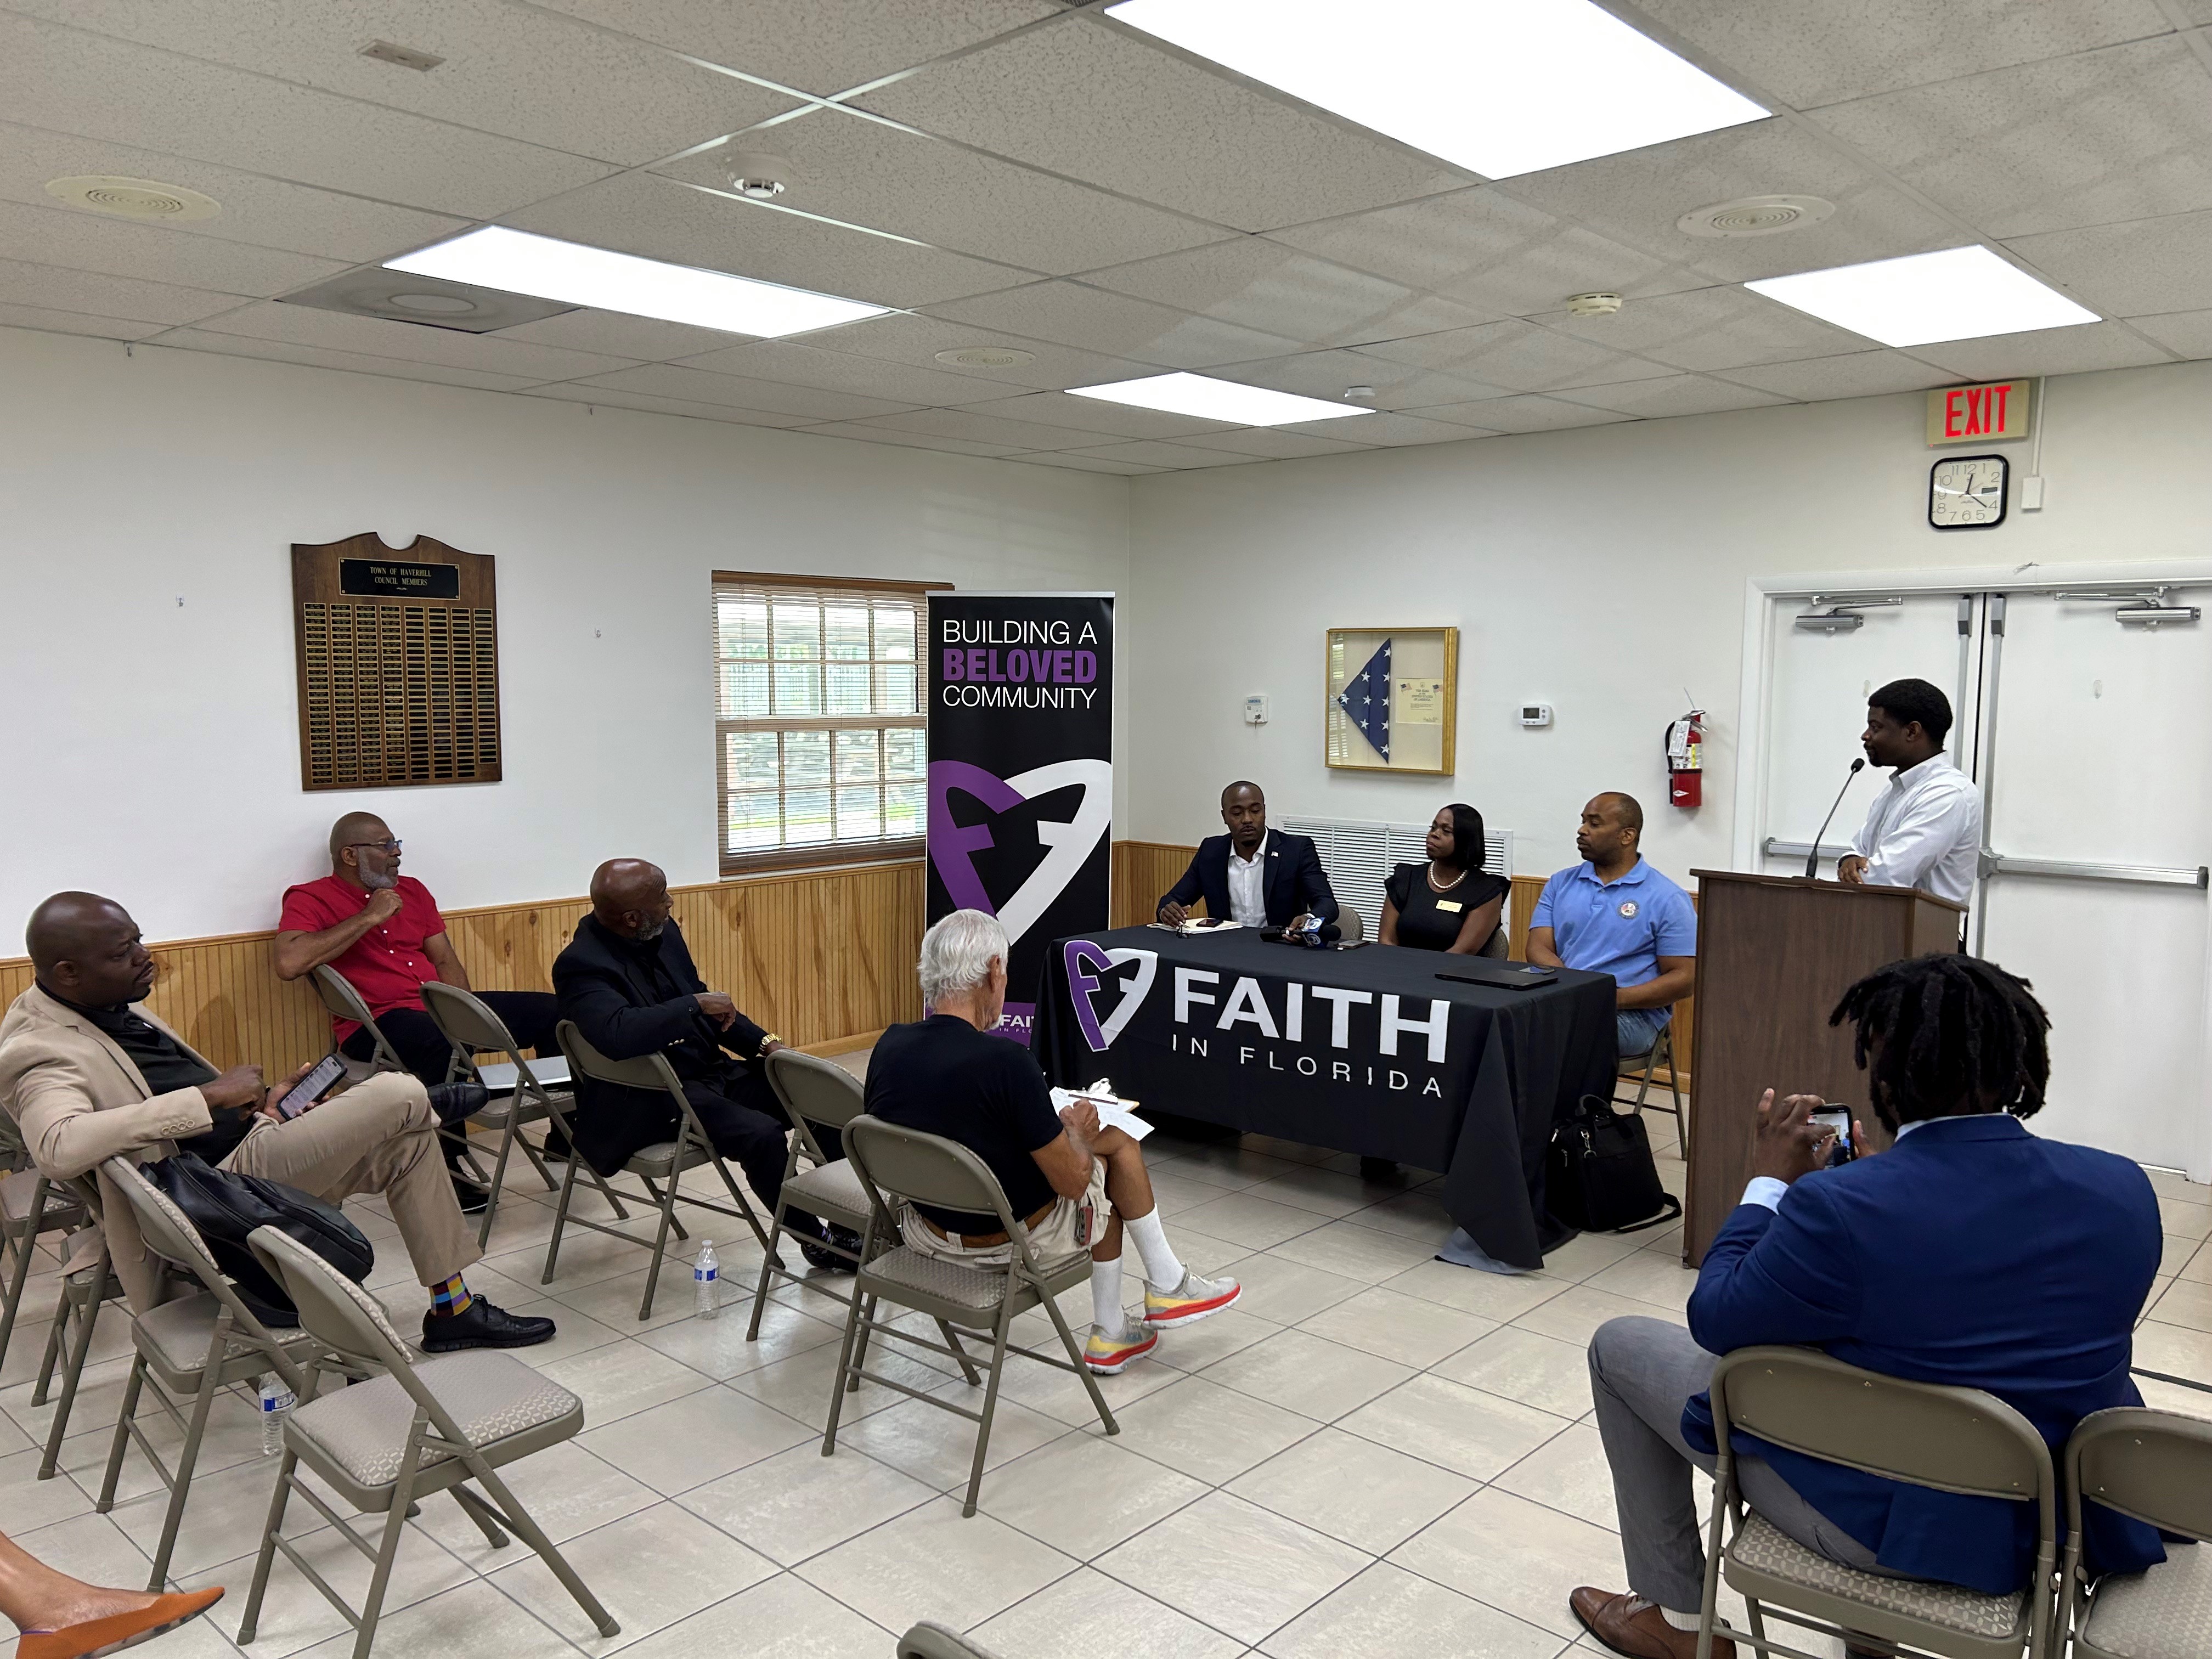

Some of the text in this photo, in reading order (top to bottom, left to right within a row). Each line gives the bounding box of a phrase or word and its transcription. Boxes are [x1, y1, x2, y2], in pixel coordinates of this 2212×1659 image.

[1945, 385, 2011, 438] EXIT
[1951, 465, 1959, 476] 11
[1963, 464, 1977, 475] 12
[1939, 475, 1953, 487] 10
[1990, 471, 2000, 483] 2
[1937, 490, 1947, 500] 9
[1936, 503, 1946, 514] 8
[1988, 500, 1998, 510] 4
[1949, 511, 1957, 522] 7
[1961, 510, 1972, 521] 6
[1976, 509, 1985, 521] 5
[369, 566, 387, 574] TOWN
[400, 568, 432, 577] HAVERHILL
[375, 576, 428, 586] COUNCIL MEMBERS
[943, 619, 1098, 645] BUILDING A
[943, 648, 1097, 683] BELOVED
[943, 685, 1098, 709] COMMUNITY
[1000, 1014, 1034, 1028] FAI
[1175, 967, 1451, 1063] FAITH
[1172, 1034, 1442, 1098] IN FLORIDA
